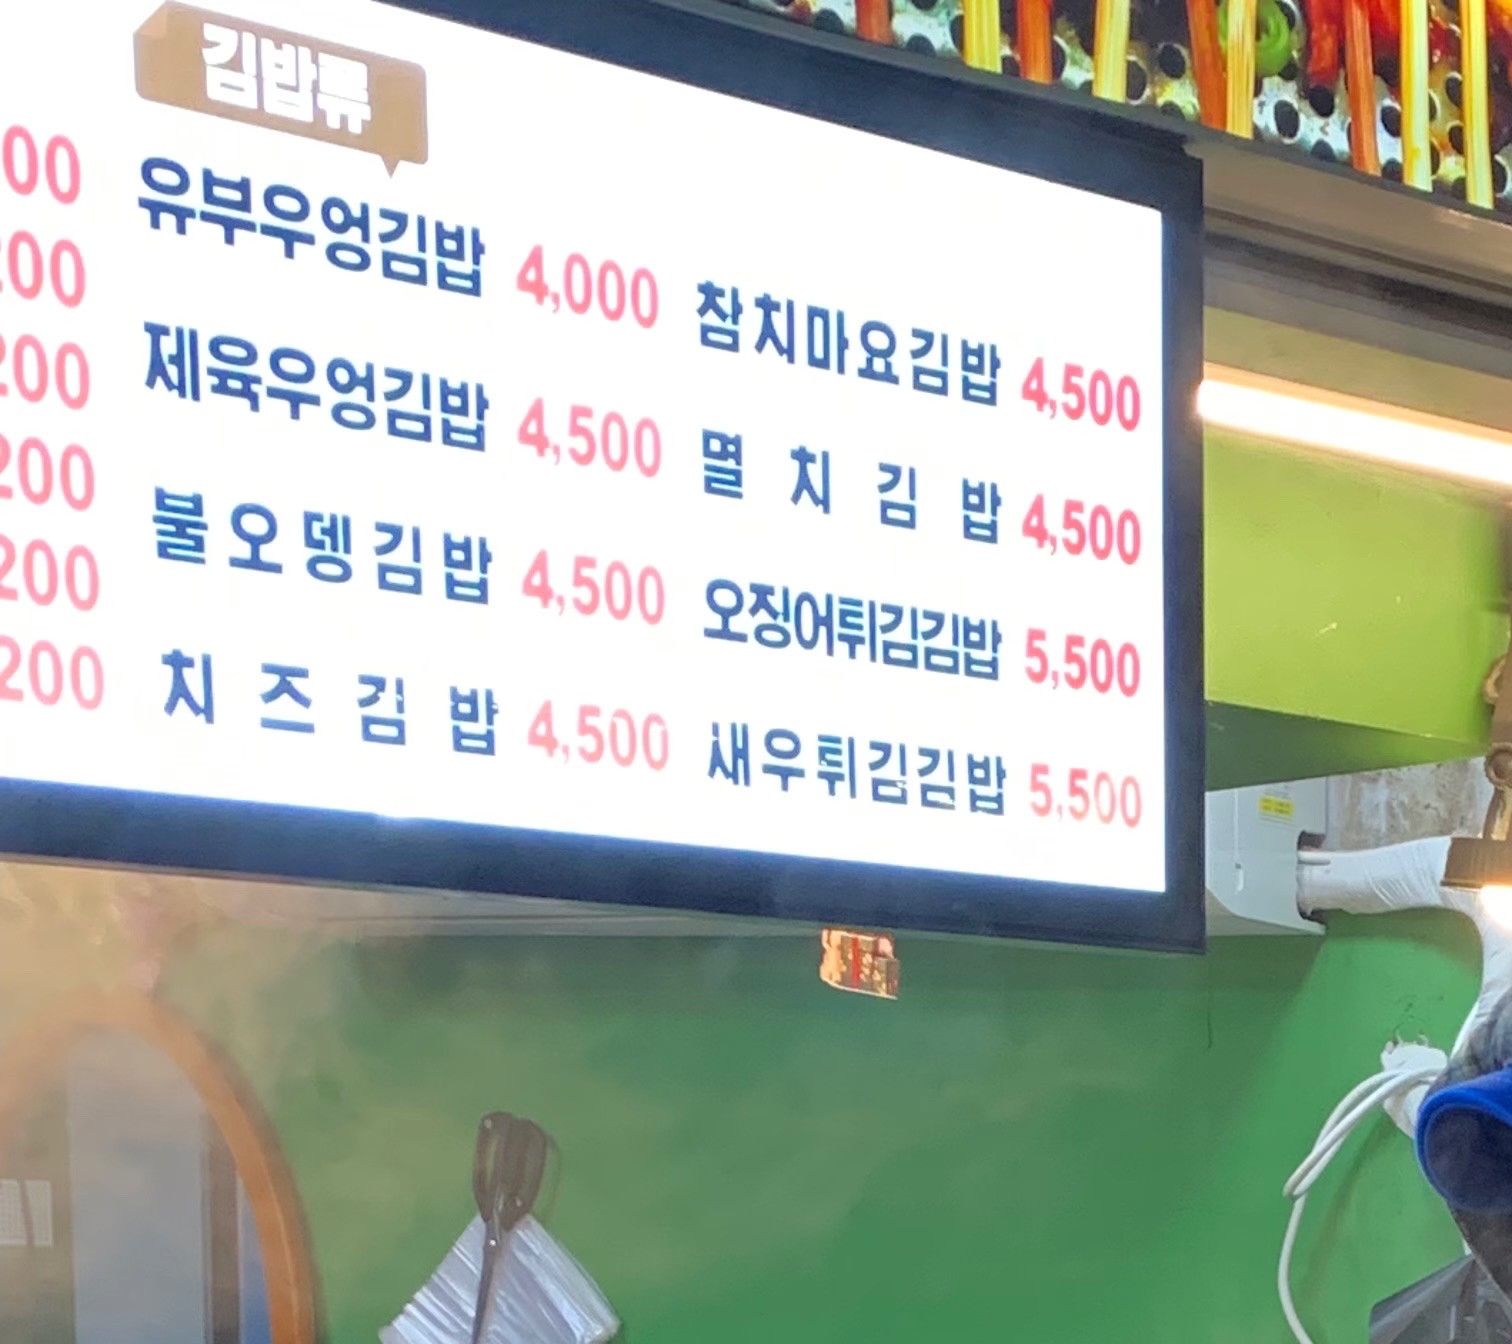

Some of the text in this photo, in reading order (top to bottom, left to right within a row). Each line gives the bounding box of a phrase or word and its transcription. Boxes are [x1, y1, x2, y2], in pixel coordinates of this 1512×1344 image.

[202, 22, 371, 134] 김밥류
[139, 158, 658, 328] 유부우엉김밥 4,000
[145, 322, 661, 477] 제육우엉김밥 4,500
[698, 282, 1141, 431] 참치마요김밥 4,500
[1022, 494, 1141, 565] 4,500
[522, 550, 665, 624] 4,500
[704, 578, 1141, 698] 오징어튀김김밥 5,500
[528, 700, 669, 770] 4,500
[708, 722, 1141, 828] 새우튀김김밥 5,500
